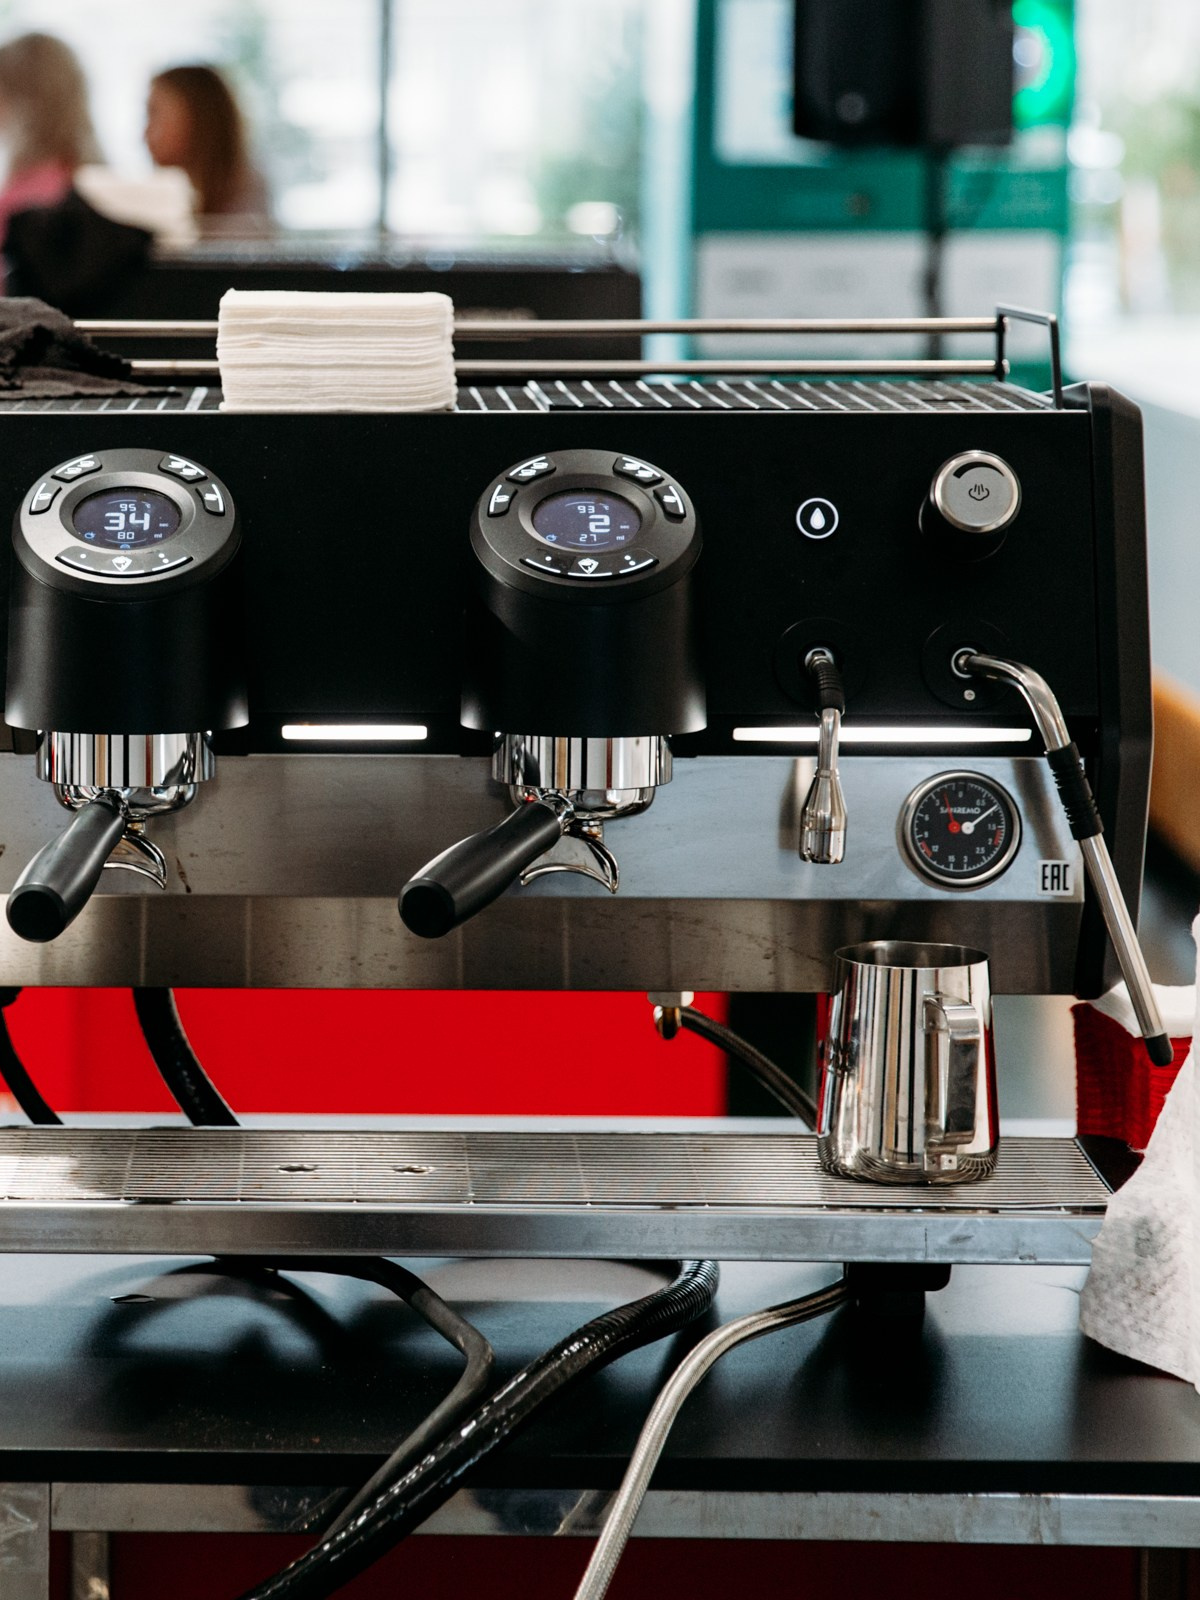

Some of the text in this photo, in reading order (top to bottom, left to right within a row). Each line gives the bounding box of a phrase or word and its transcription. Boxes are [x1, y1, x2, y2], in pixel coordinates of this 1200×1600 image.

[119, 503, 137, 512] 95
[577, 505, 596, 514] 93
[103, 512, 151, 531] 34
[588, 514, 611, 533] 2
[117, 531, 135, 540] 80
[579, 533, 597, 542] 27
[1042, 864, 1070, 891] EAC
